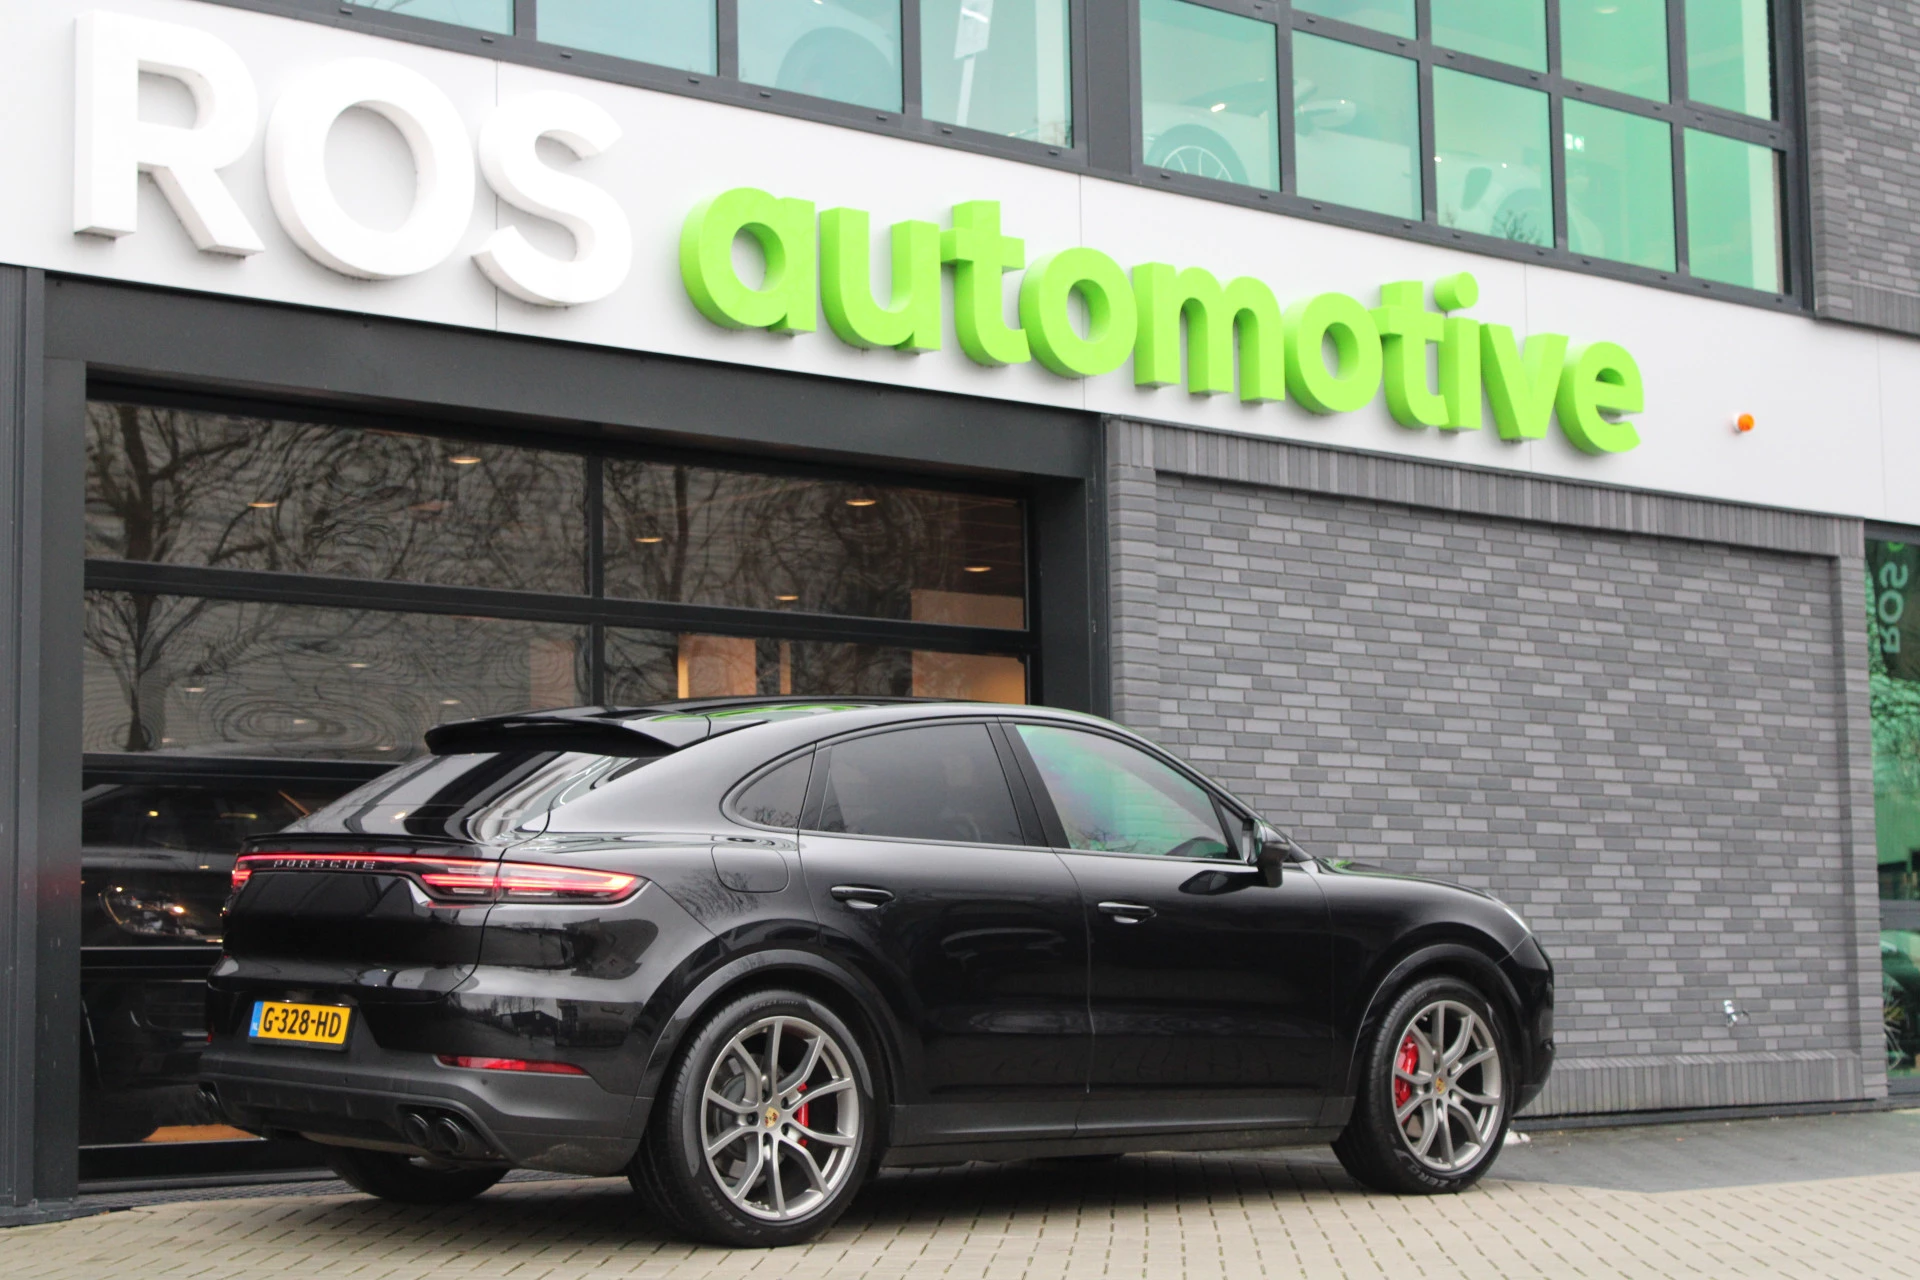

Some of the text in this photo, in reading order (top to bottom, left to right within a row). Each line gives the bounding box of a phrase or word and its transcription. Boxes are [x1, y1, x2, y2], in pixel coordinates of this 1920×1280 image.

[74, 10, 1643, 454] ROS automotive
[273, 859, 376, 870] PORSCHE
[263, 1007, 342, 1038] G-328-HD
